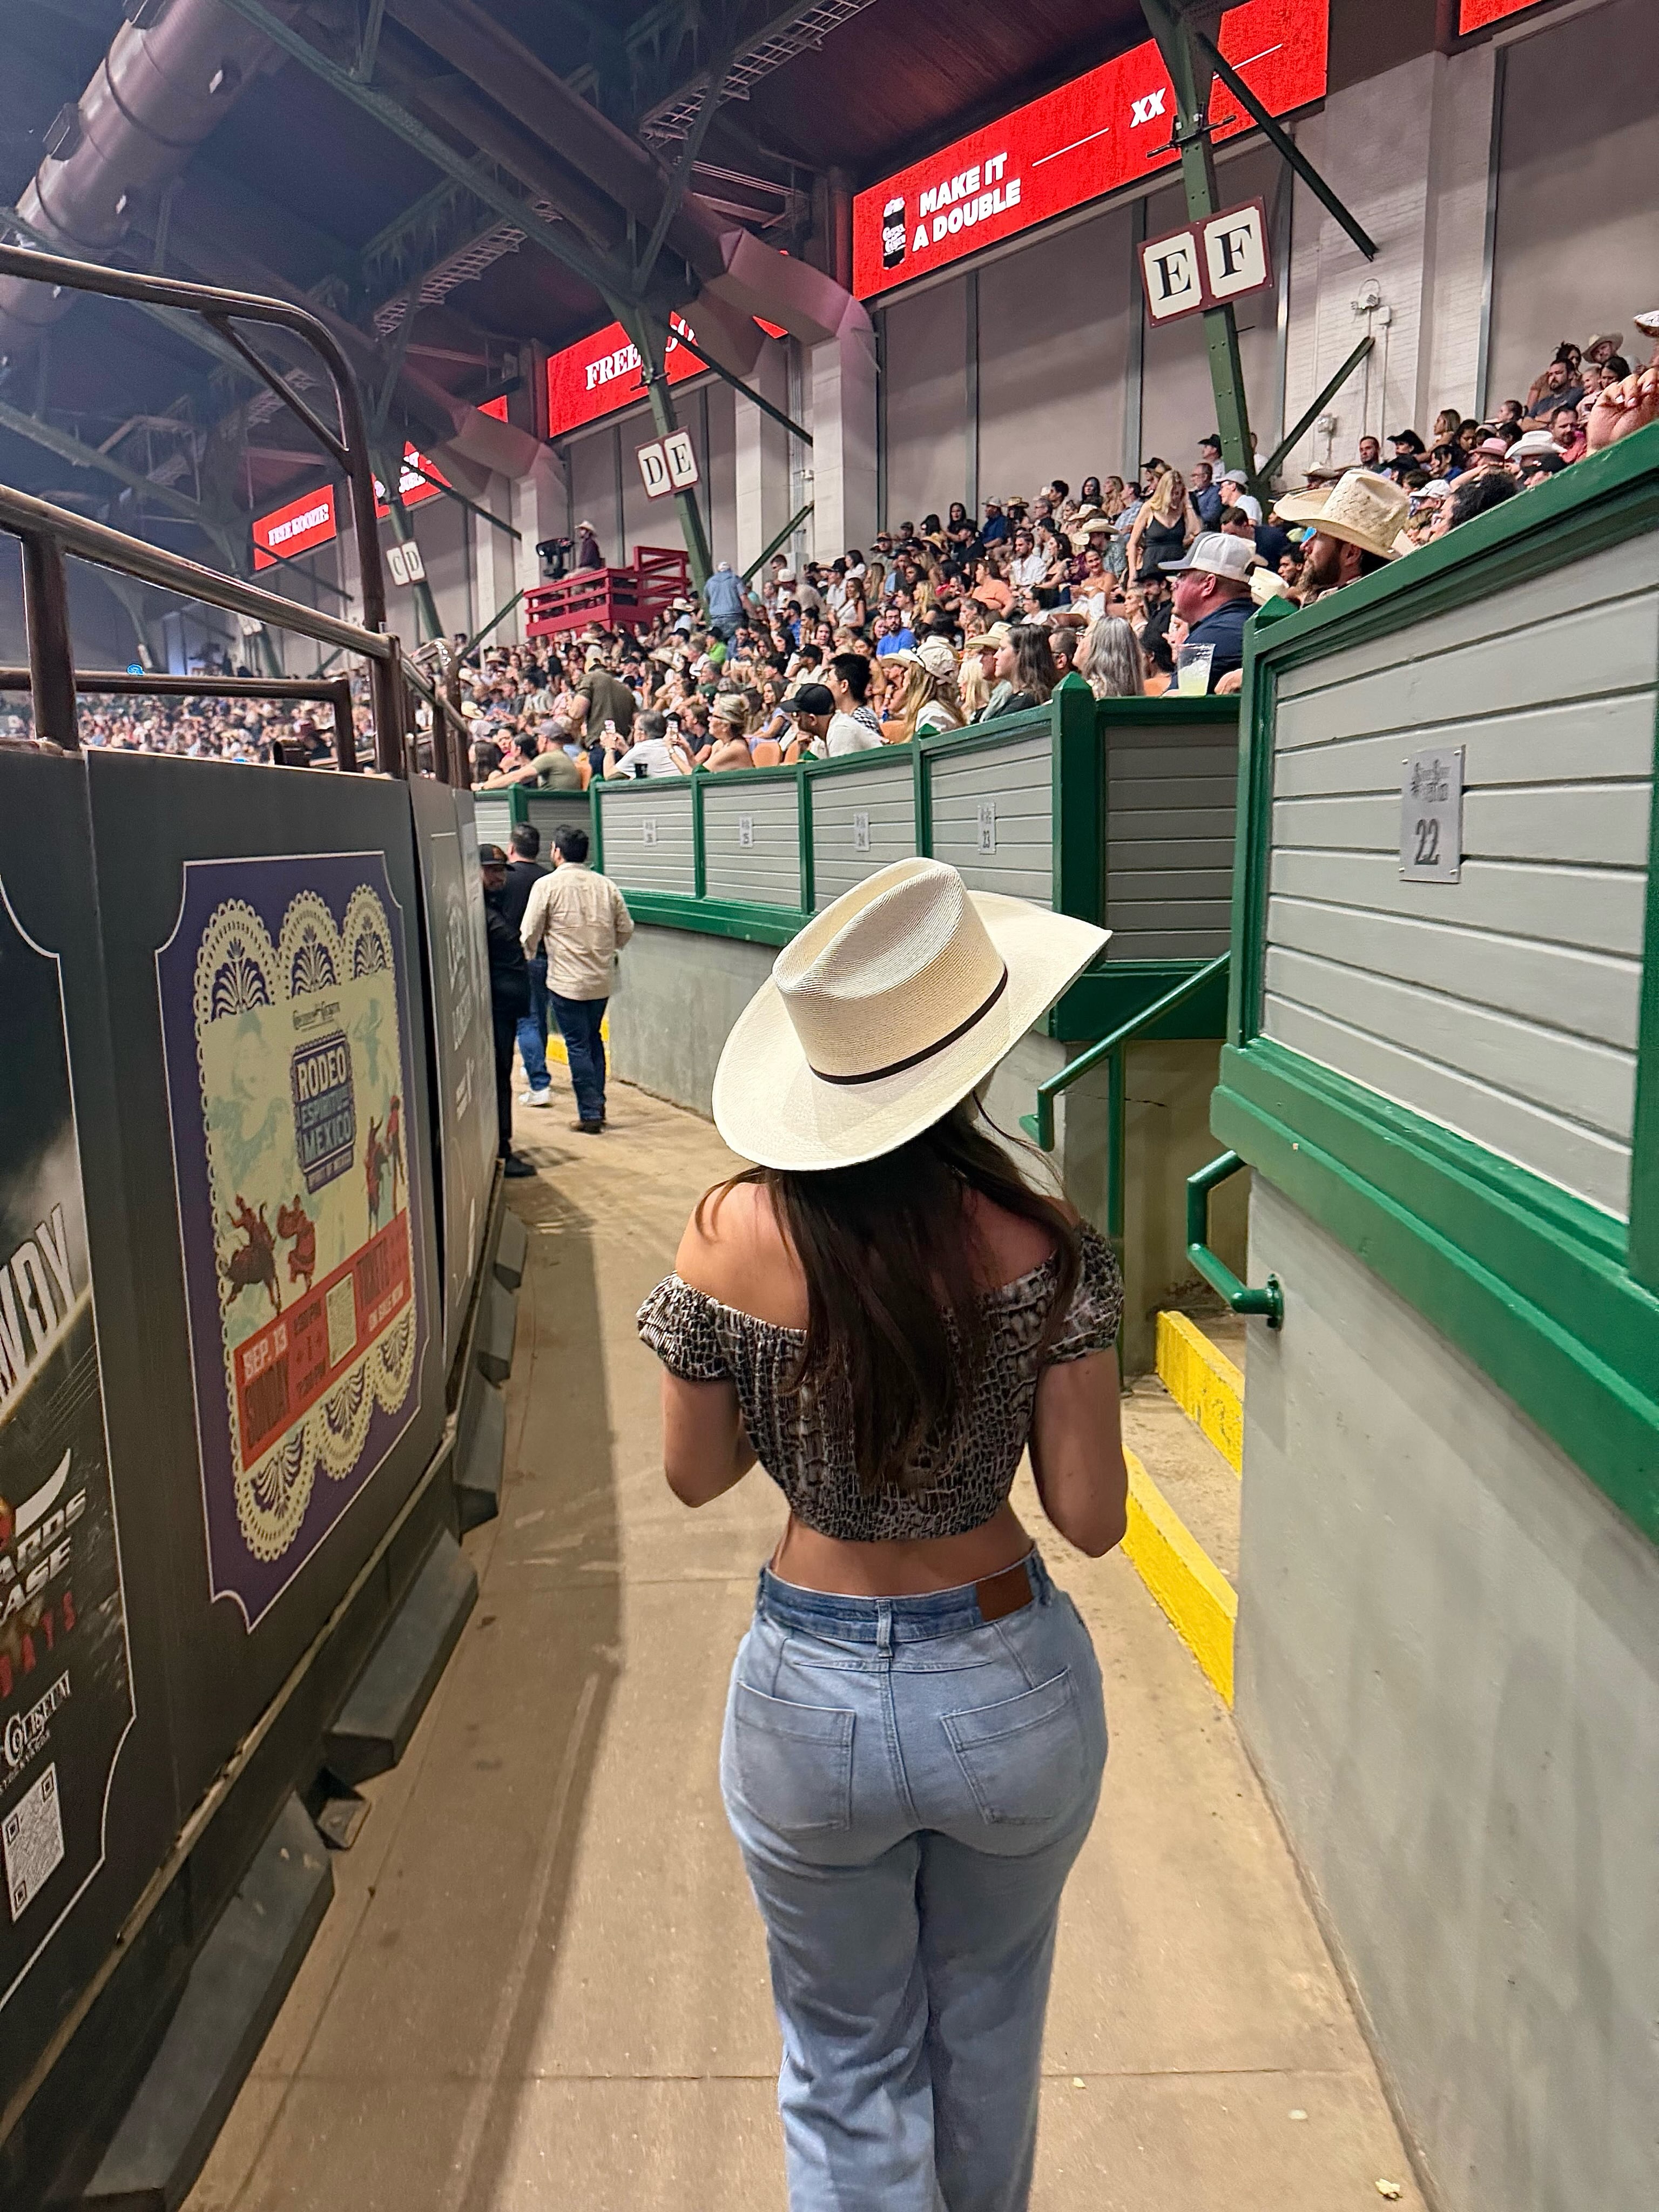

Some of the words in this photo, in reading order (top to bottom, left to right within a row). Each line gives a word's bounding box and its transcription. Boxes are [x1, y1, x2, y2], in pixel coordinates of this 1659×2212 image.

[1130, 87, 1166, 128] XX
[920, 165, 980, 218] MAKE
[984, 152, 1007, 185] IT
[912, 224, 929, 252] A
[933, 178, 1021, 242] DOUBLE
[1152, 248, 1192, 300] E
[1214, 224, 1252, 279] F
[585, 343, 642, 390] FREE
[643, 456, 663, 485] D
[670, 443, 692, 476] E
[406, 551, 419, 571] D
[1413, 818, 1440, 865] 22
[298, 1046, 346, 1102] RODEO
